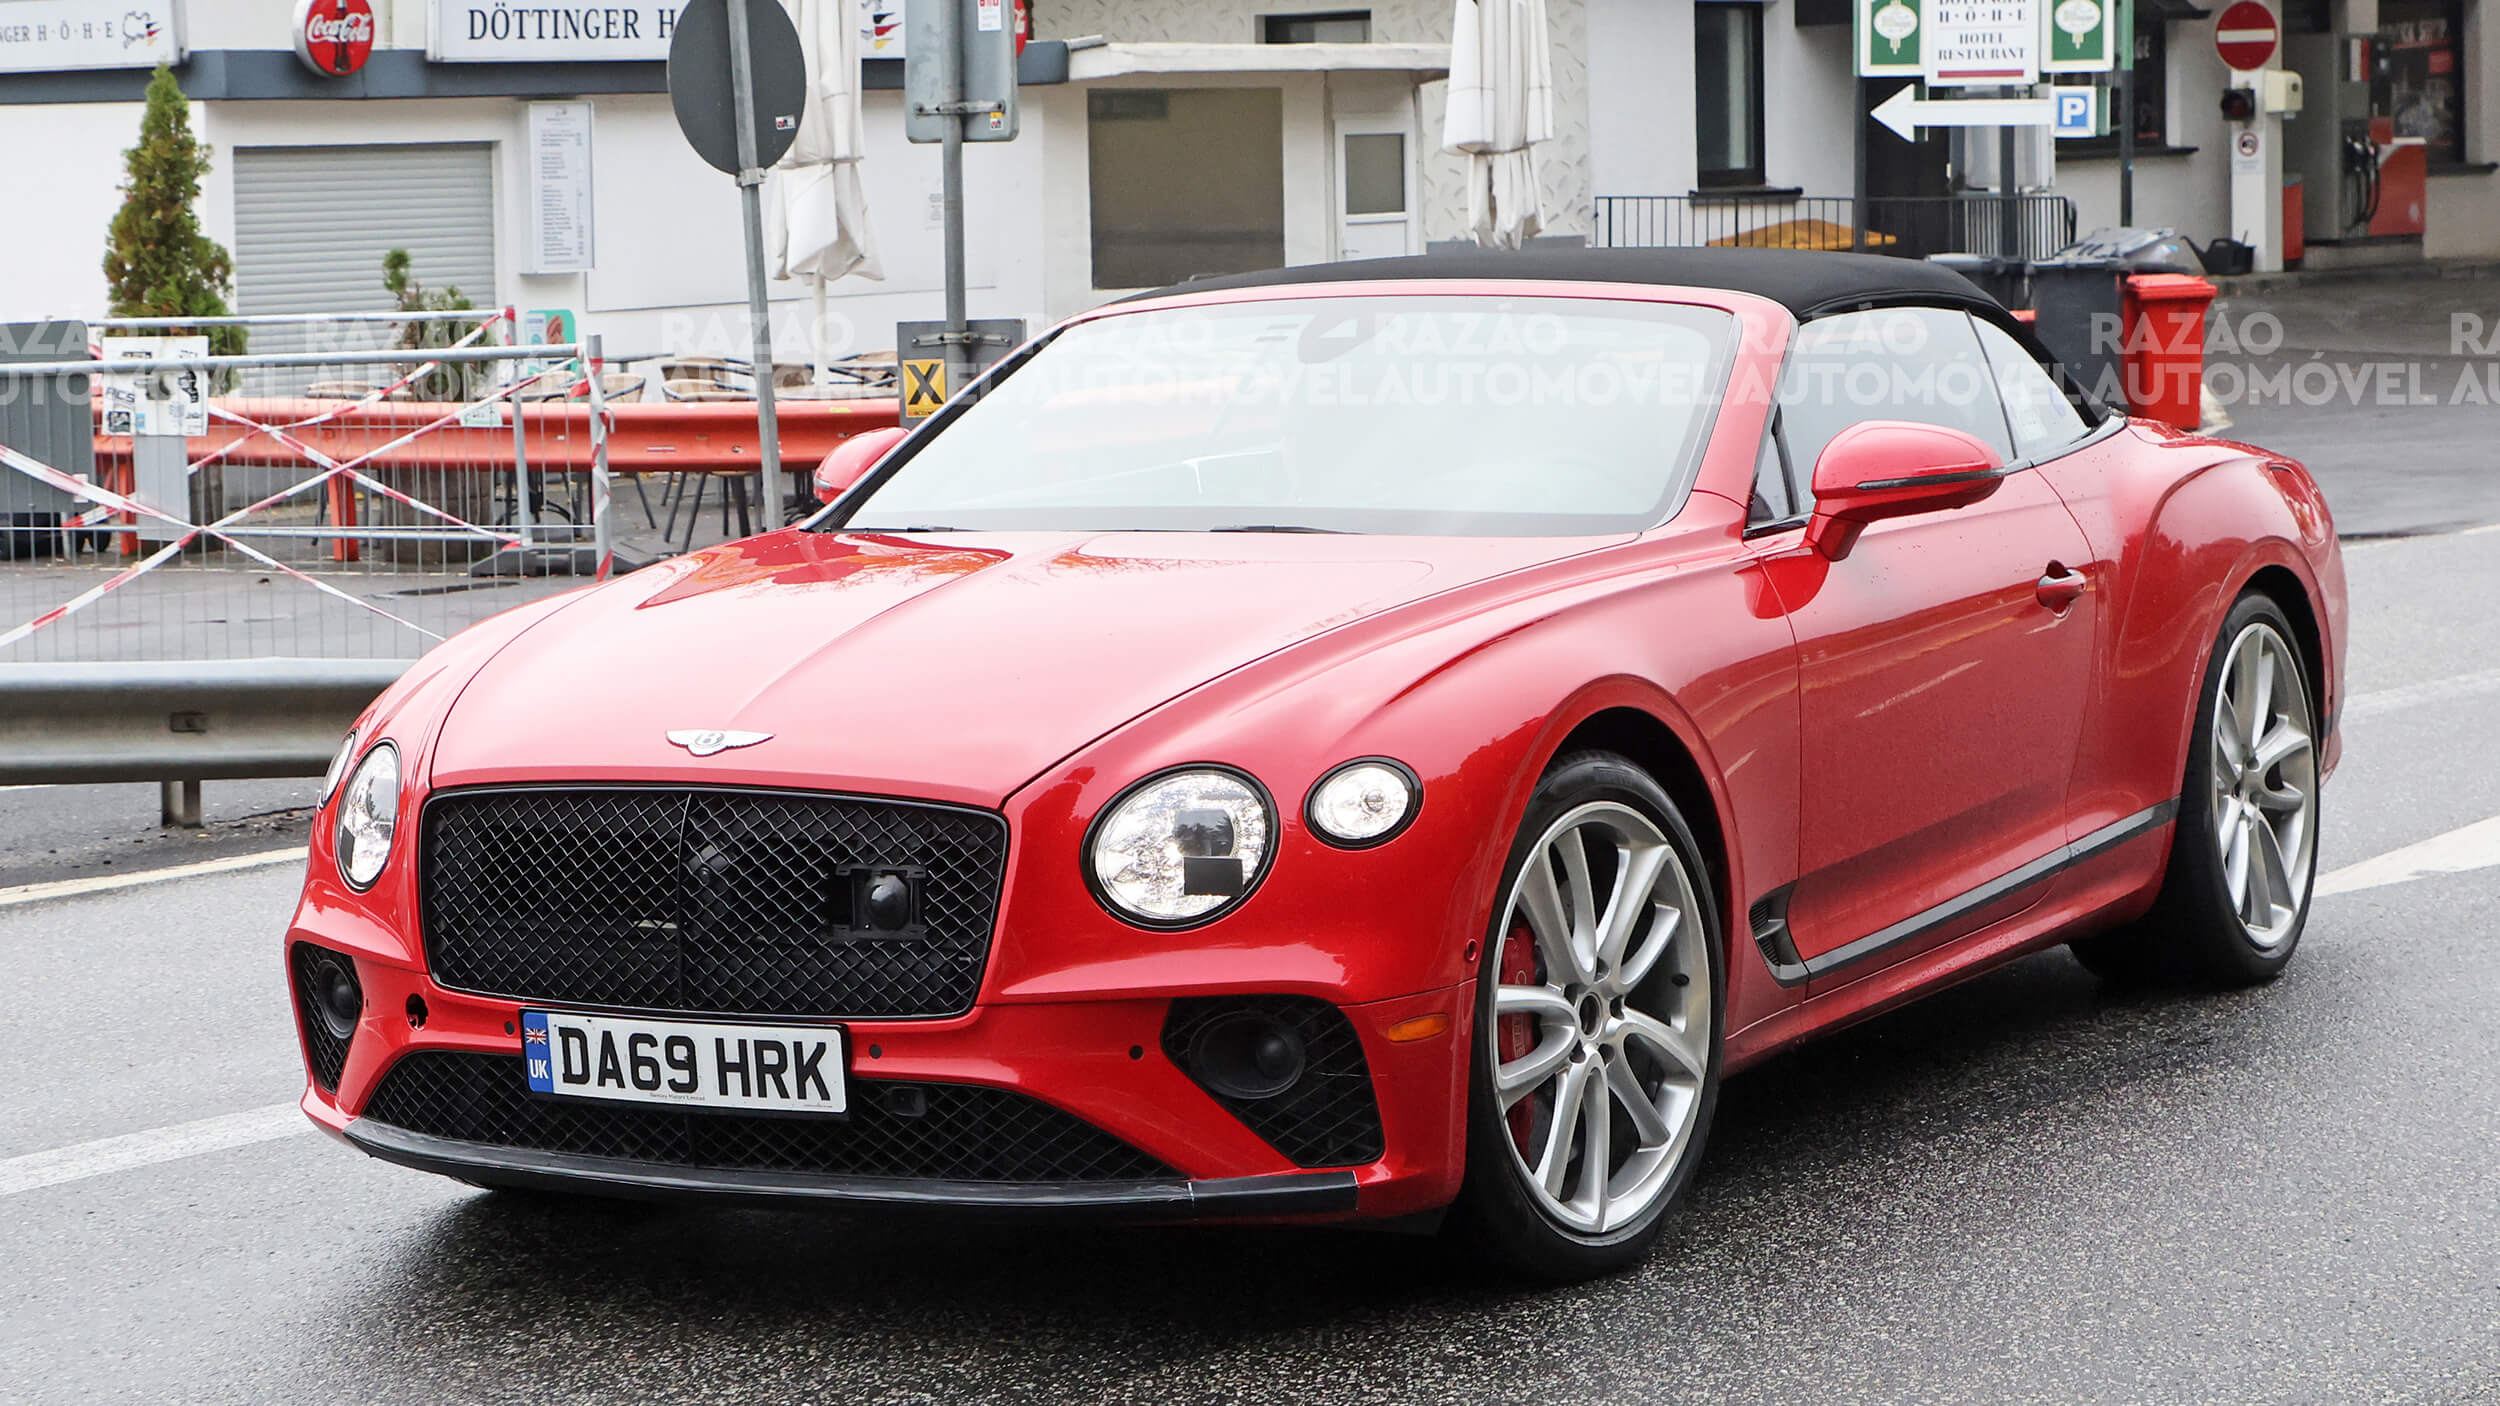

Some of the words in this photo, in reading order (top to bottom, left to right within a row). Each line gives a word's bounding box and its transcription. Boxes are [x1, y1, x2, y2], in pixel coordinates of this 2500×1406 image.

[467, 2, 641, 40] DÖTTINGER
[1959, 31, 2005, 45] HOTEL
[1938, 47, 2027, 61] RESTAURANT
[2062, 97, 2087, 125] P
[530, 1059, 549, 1079] UK
[558, 1026, 698, 1094] DA69
[714, 1038, 831, 1101] HRK
